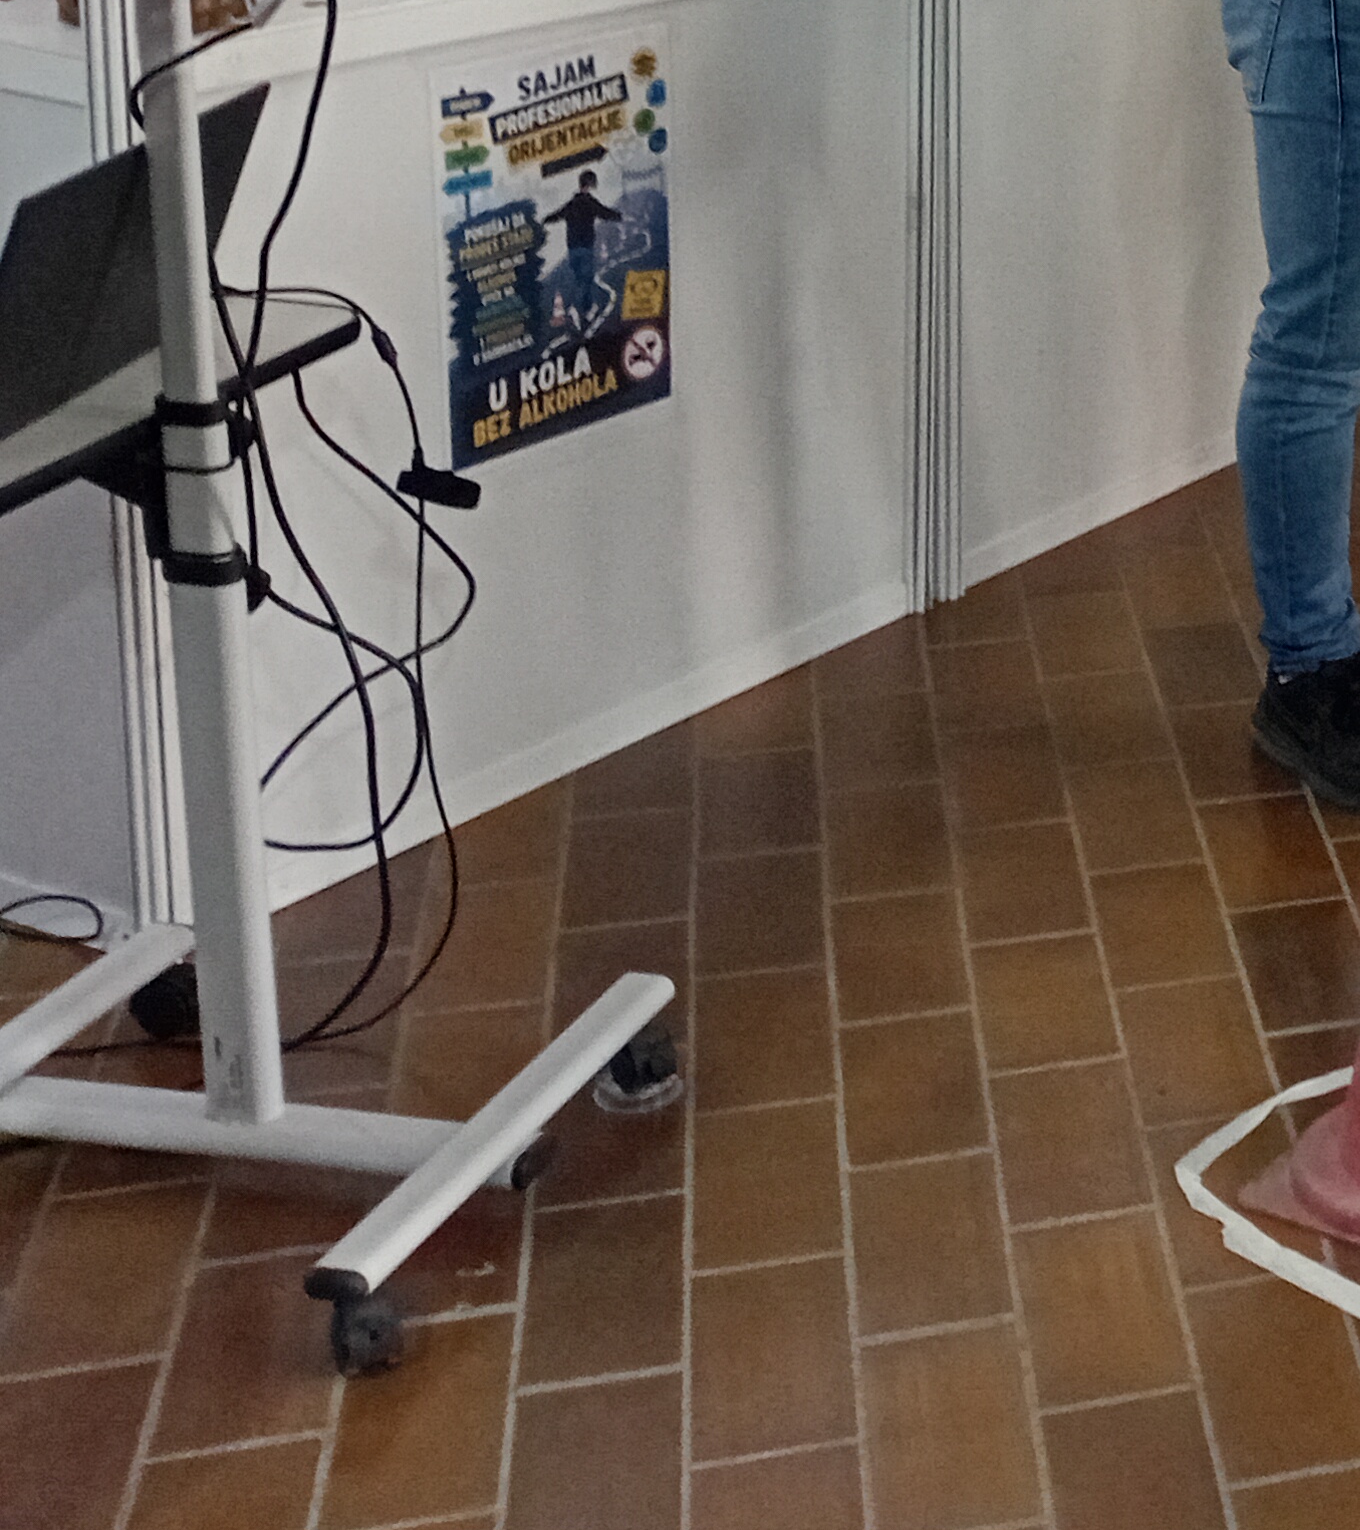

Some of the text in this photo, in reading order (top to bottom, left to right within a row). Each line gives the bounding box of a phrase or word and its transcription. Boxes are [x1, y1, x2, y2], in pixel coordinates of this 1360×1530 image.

[495, 76, 625, 139] PROFESIONALNE
[517, 55, 597, 102] SAJAM
[508, 108, 623, 165] ORIJENTACIJE
[473, 366, 619, 449] BEZ ALKOHOLA
[488, 376, 509, 413] U
[519, 346, 593, 401] KOLA
